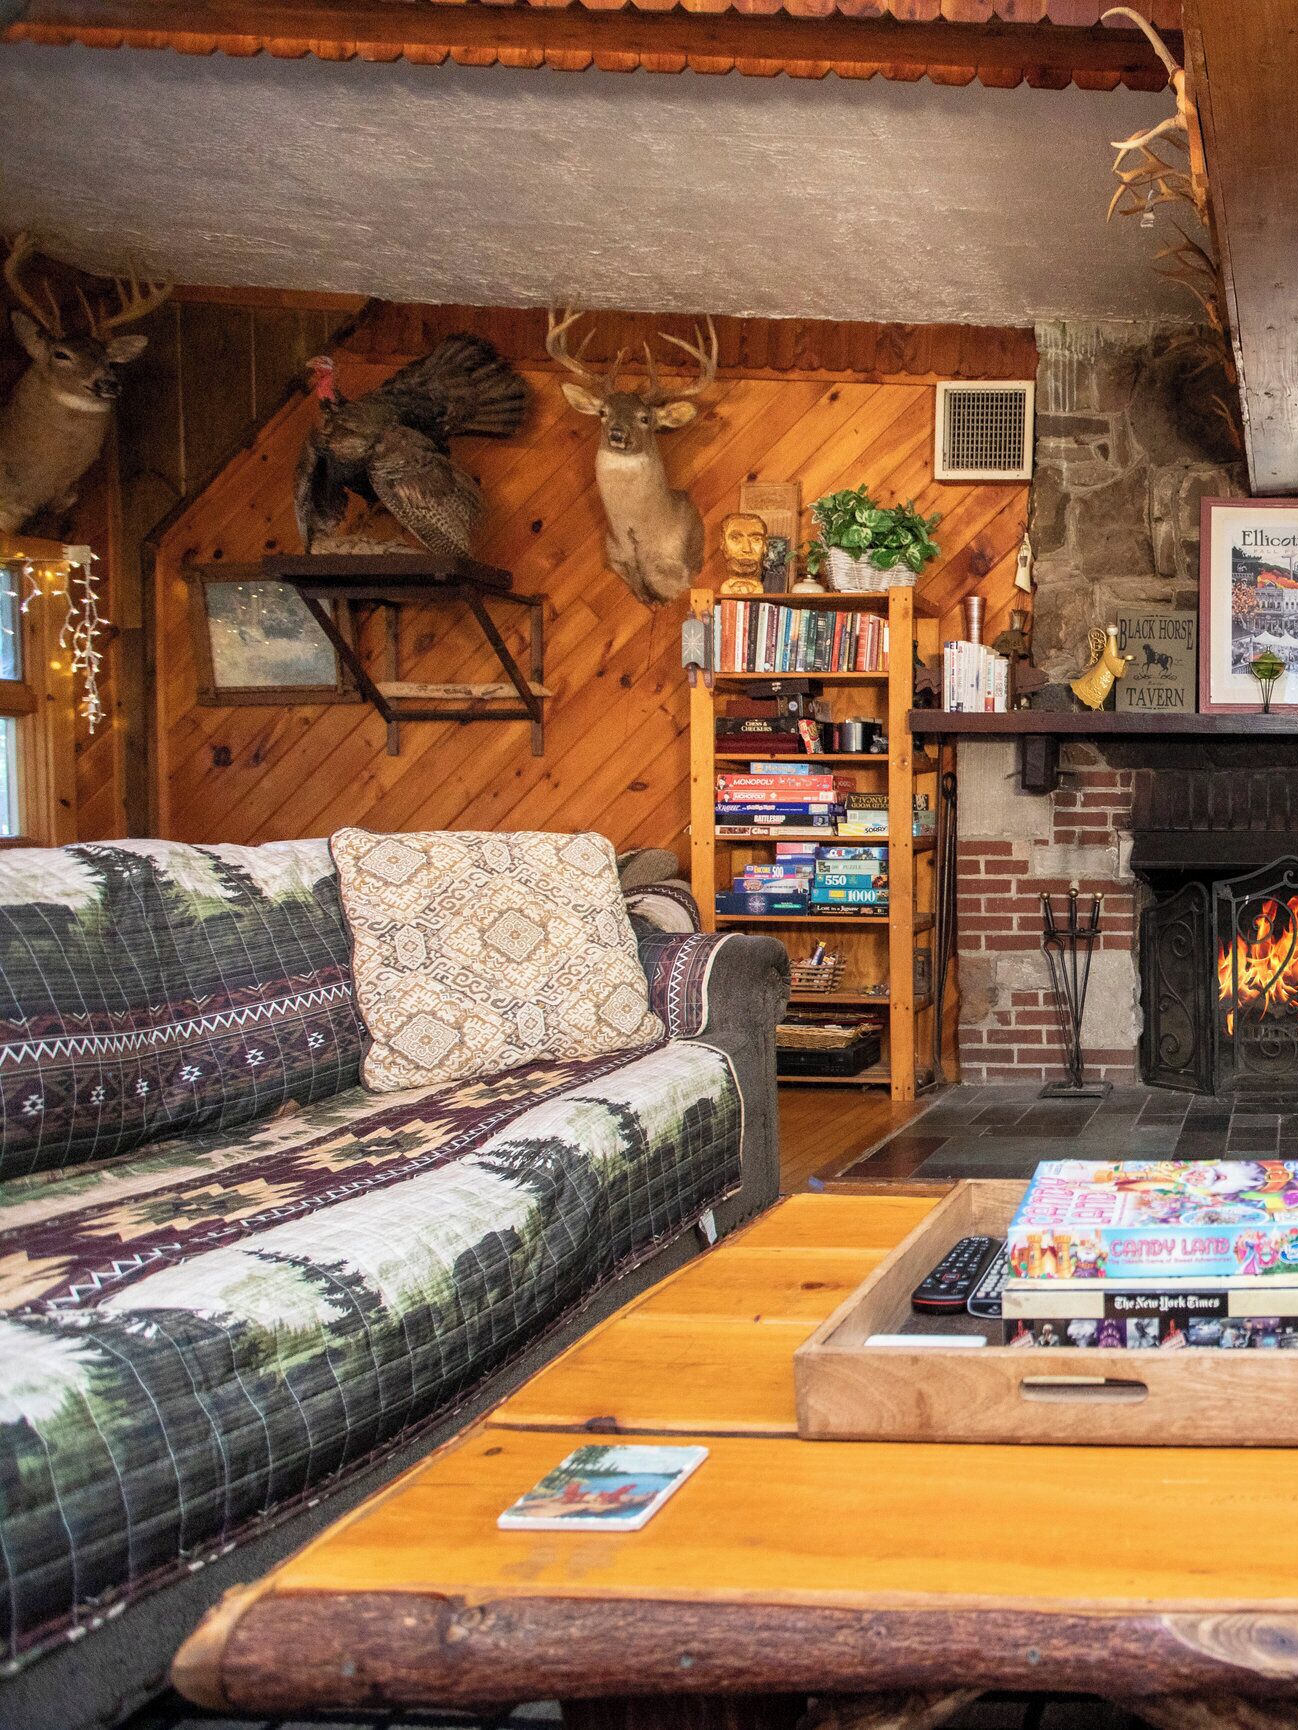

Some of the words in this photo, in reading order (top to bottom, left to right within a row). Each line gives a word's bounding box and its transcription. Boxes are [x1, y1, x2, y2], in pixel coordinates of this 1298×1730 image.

[1118, 618, 1156, 650] BLACK
[1158, 619, 1194, 650] HORSE
[1126, 687, 1185, 707] TAVERN
[732, 778, 774, 786] MONOPOLY
[753, 814, 786, 823] BATTLESHIP
[751, 827, 769, 835] Clue
[772, 866, 784, 878] 500
[824, 874, 847, 886] 550
[847, 889, 876, 902] 1000
[1022, 1176, 1075, 1225] CANDY
[1069, 1192, 1117, 1225] LAND
[1110, 1238, 1176, 1257] CANDY
[1181, 1237, 1230, 1255] LAND
[1114, 1296, 1135, 1310] The
[1135, 1296, 1159, 1309] New
[1159, 1295, 1187, 1311] York
[1187, 1295, 1220, 1309] Times
